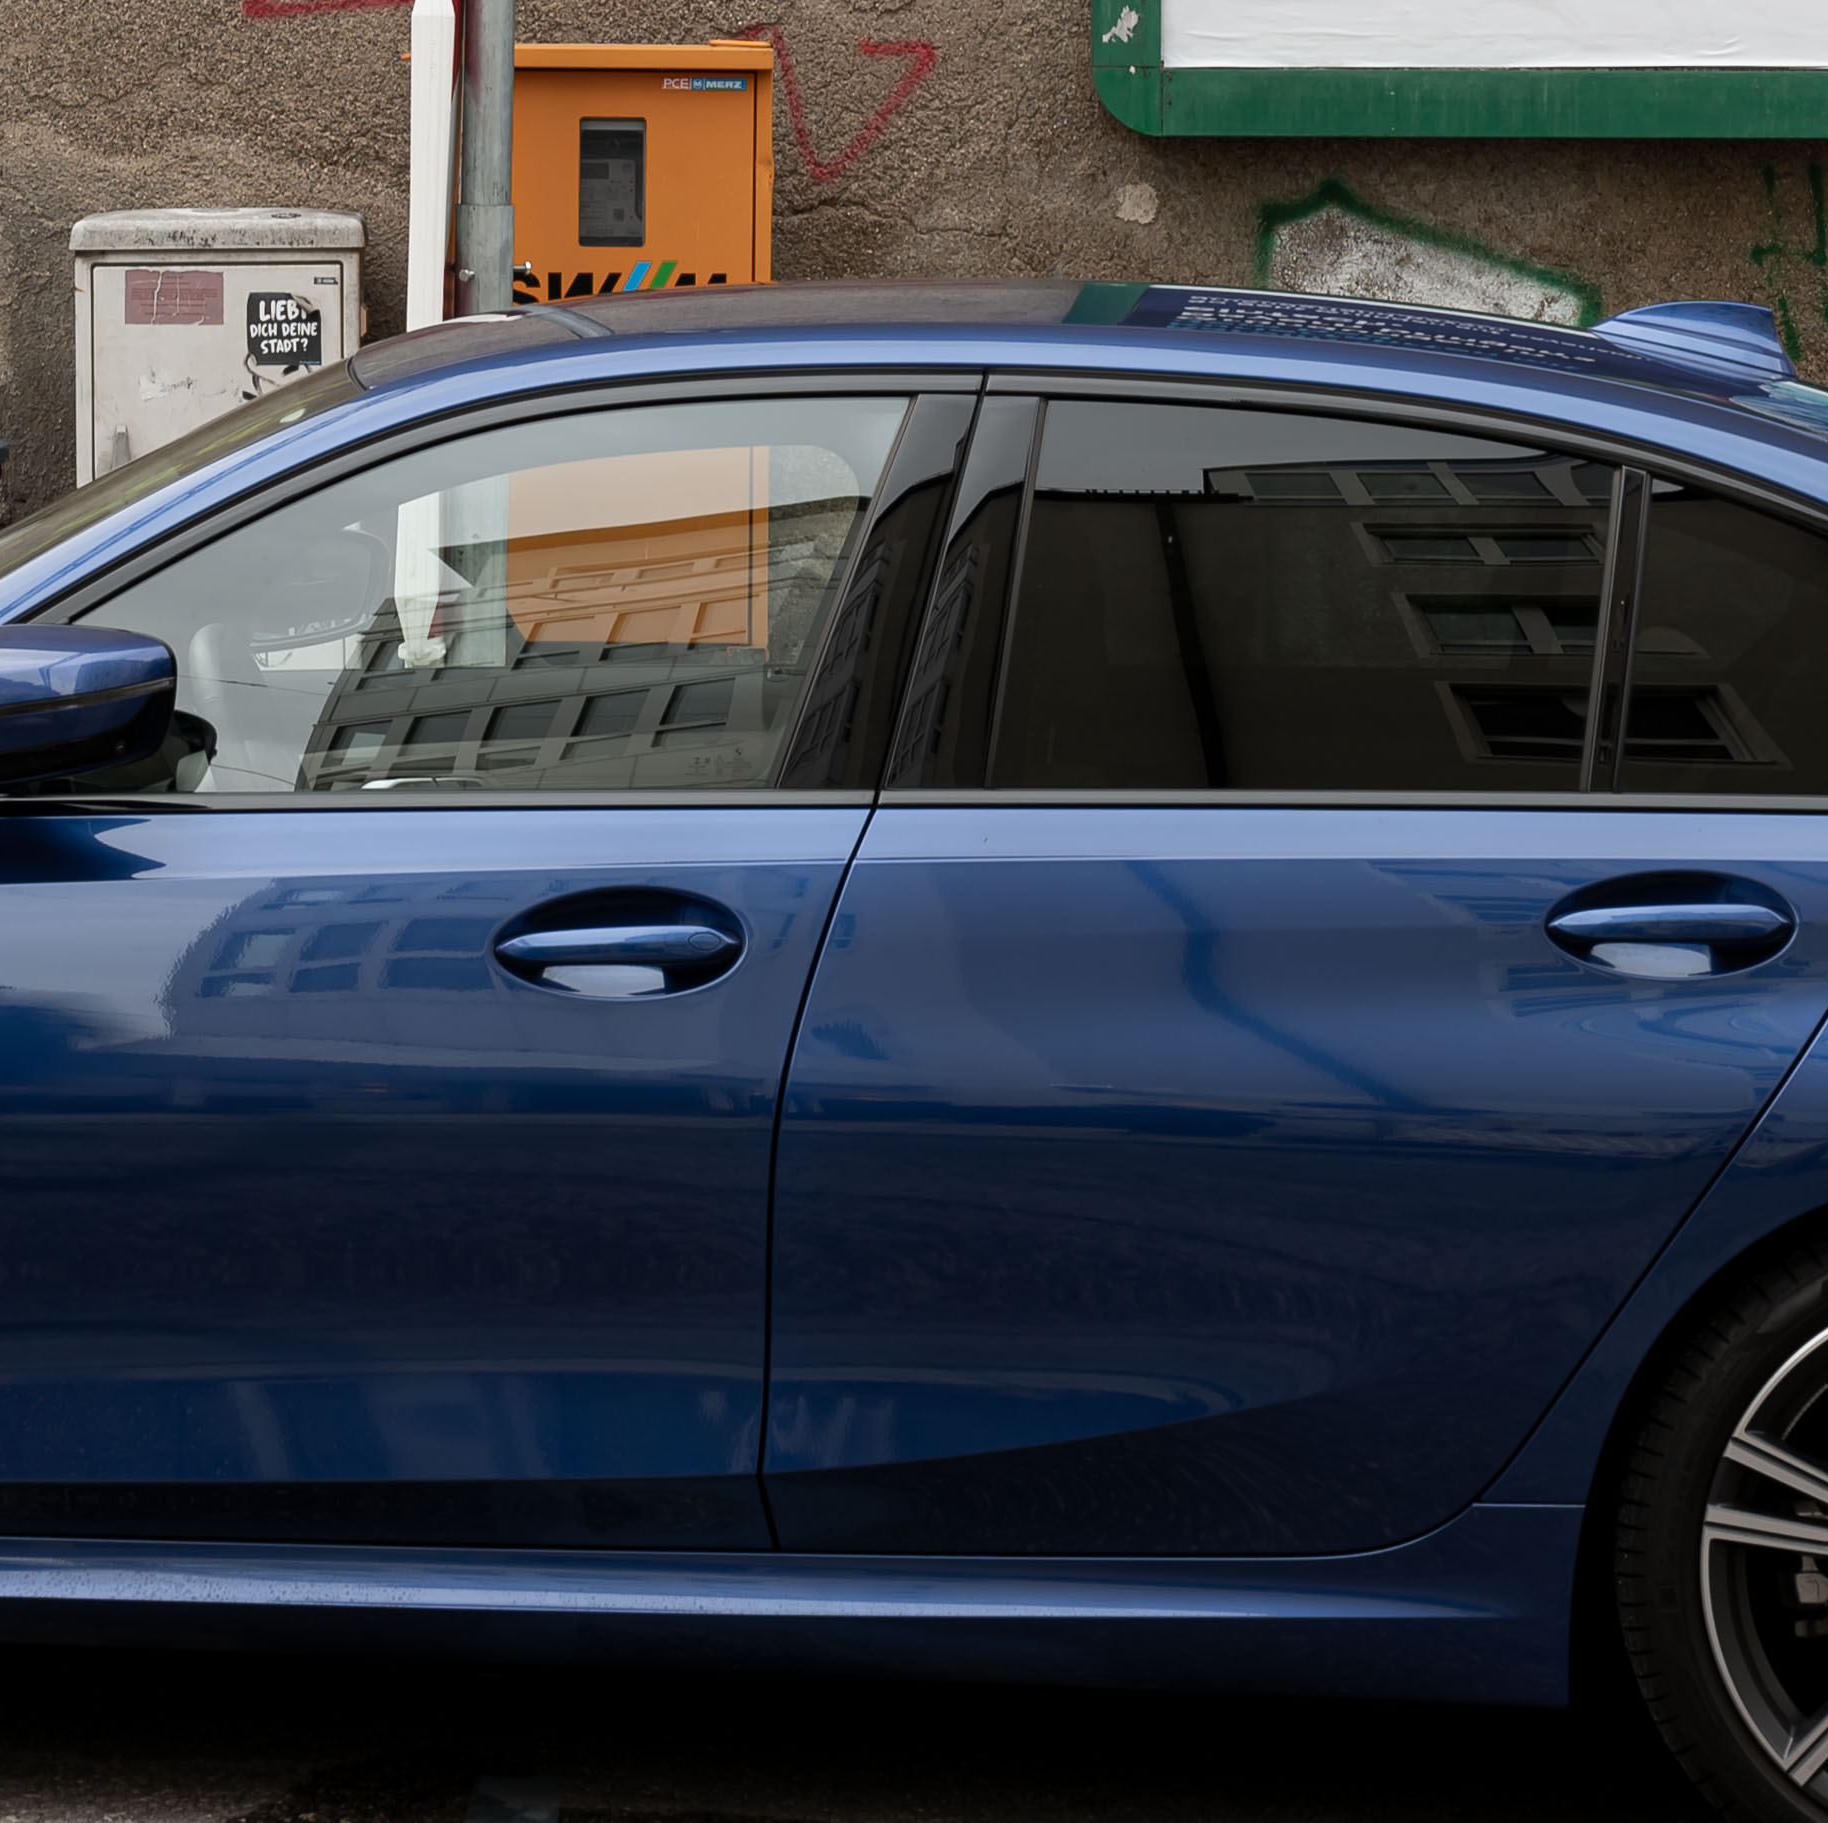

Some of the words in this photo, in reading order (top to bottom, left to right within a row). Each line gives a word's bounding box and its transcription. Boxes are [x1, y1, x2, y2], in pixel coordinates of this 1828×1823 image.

[663, 77, 689, 90] PCE
[706, 80, 742, 89] MERZ
[250, 322, 278, 338] DICH
[281, 321, 318, 337] DEINE
